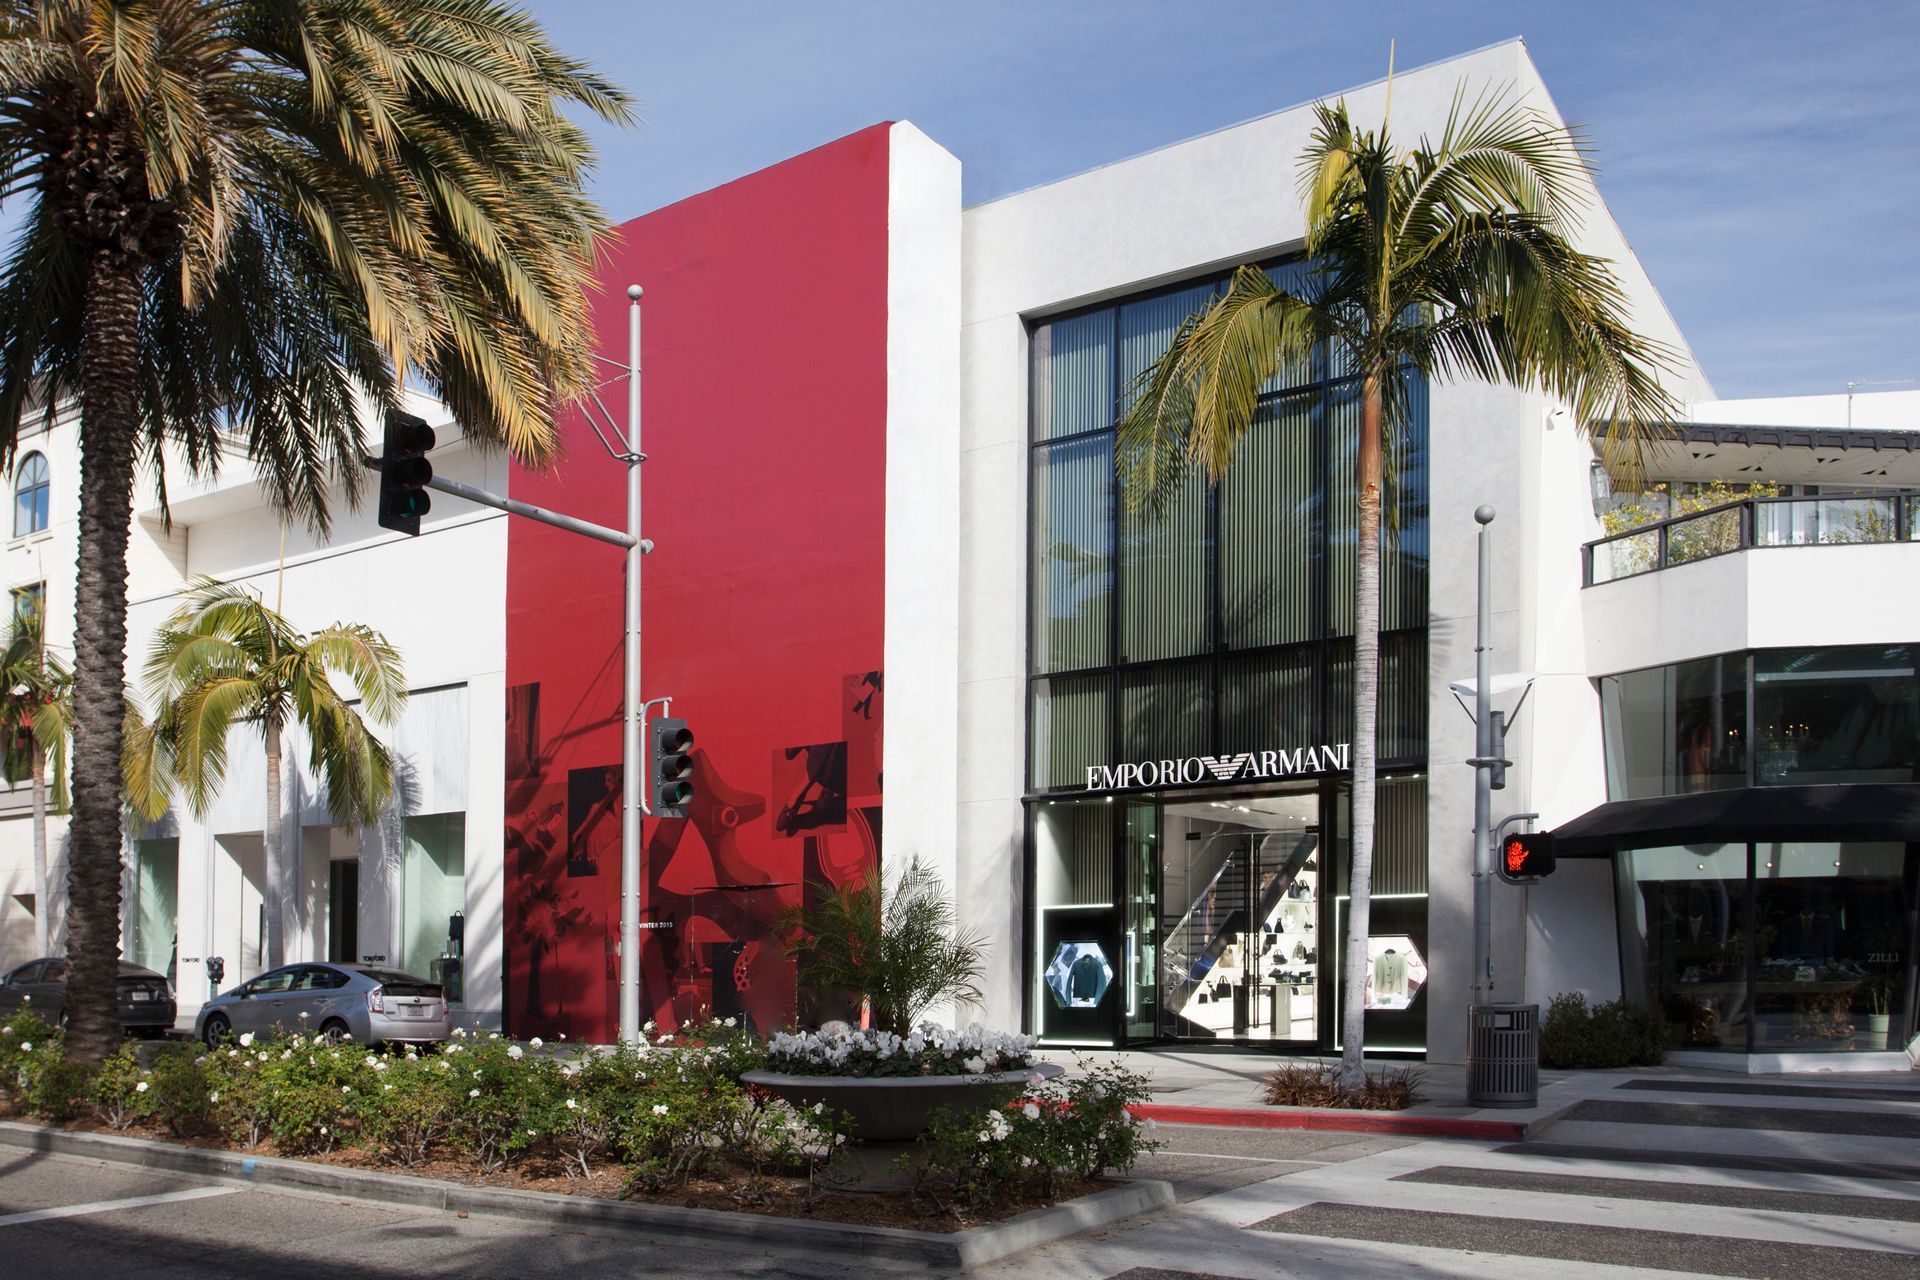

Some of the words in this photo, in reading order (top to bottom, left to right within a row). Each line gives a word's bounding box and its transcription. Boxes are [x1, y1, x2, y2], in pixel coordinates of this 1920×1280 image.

[1086, 757, 1205, 791] EMPORIO
[1241, 743, 1350, 779] ARMANI
[1867, 952, 1900, 963] ZILLI
